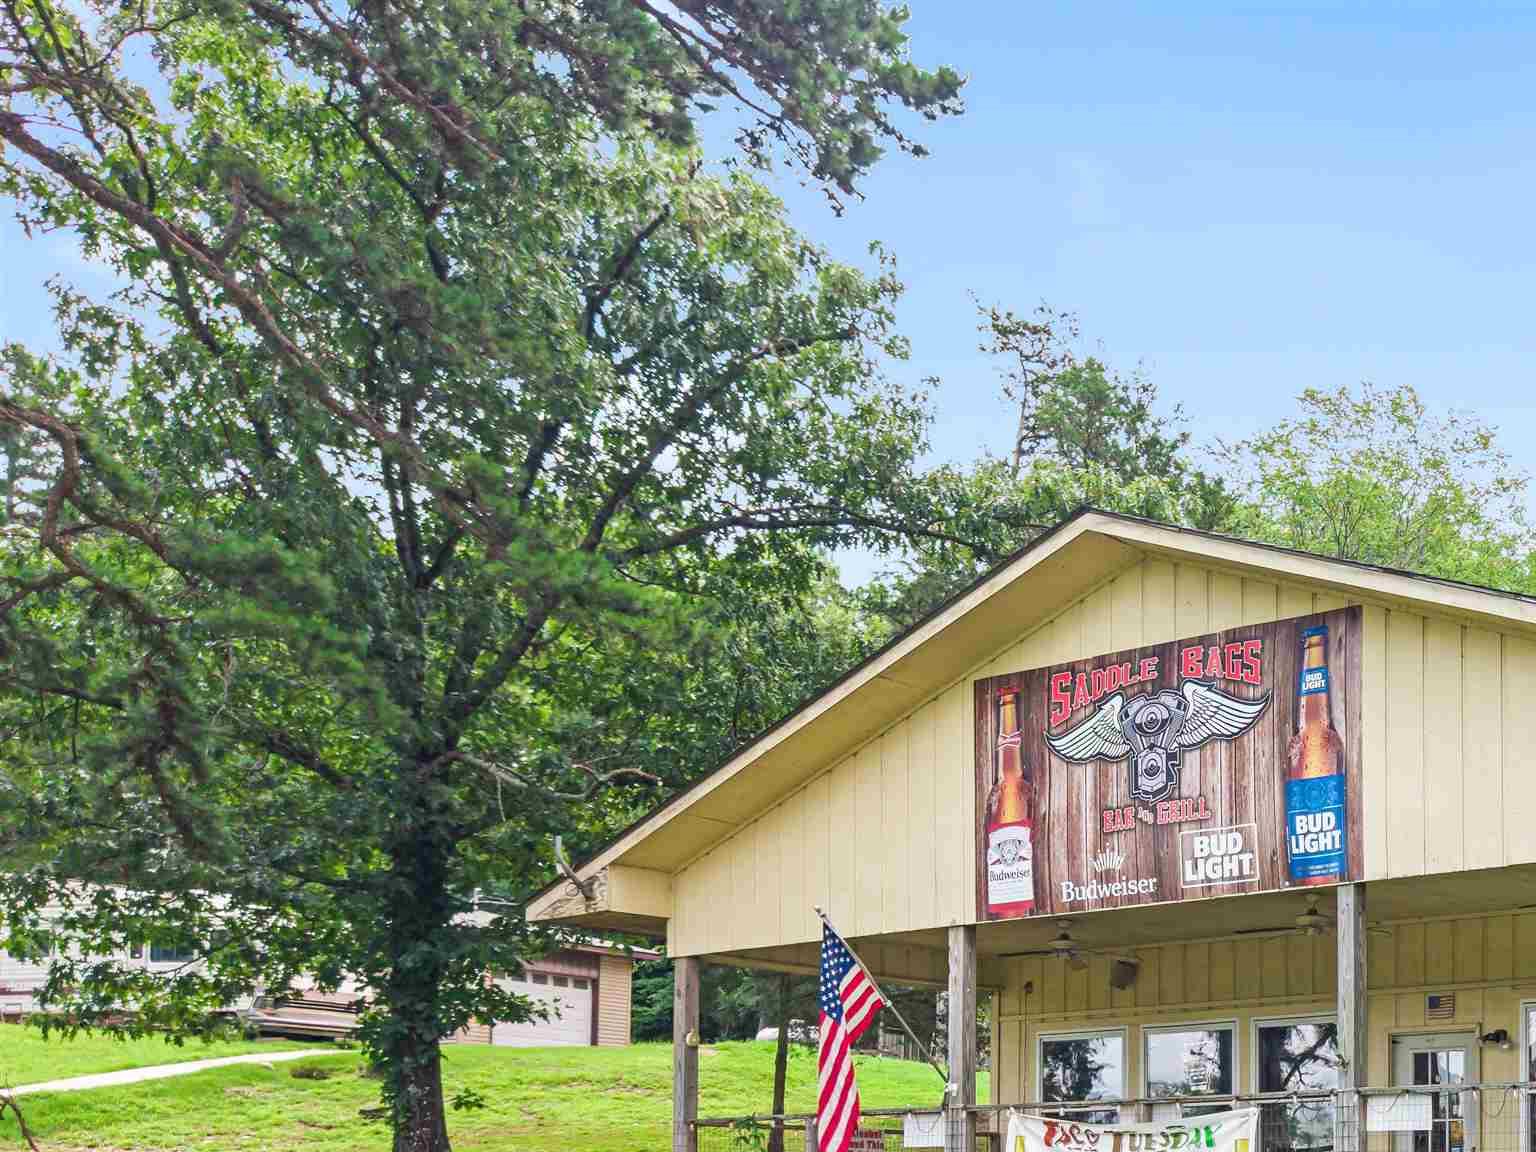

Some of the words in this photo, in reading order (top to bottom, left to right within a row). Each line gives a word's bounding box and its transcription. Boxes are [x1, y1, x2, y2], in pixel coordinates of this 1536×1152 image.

[1050, 656, 1160, 727] SADDLE
[1181, 639, 1263, 685] BAGS
[1156, 796, 1211, 825] GRILL
[1295, 811, 1336, 835] BUD
[1193, 832, 1243, 858] BUD
[1291, 829, 1342, 854] LIGHT
[1185, 852, 1253, 882] LIGHT
[1061, 875, 1157, 903] Budweiser
